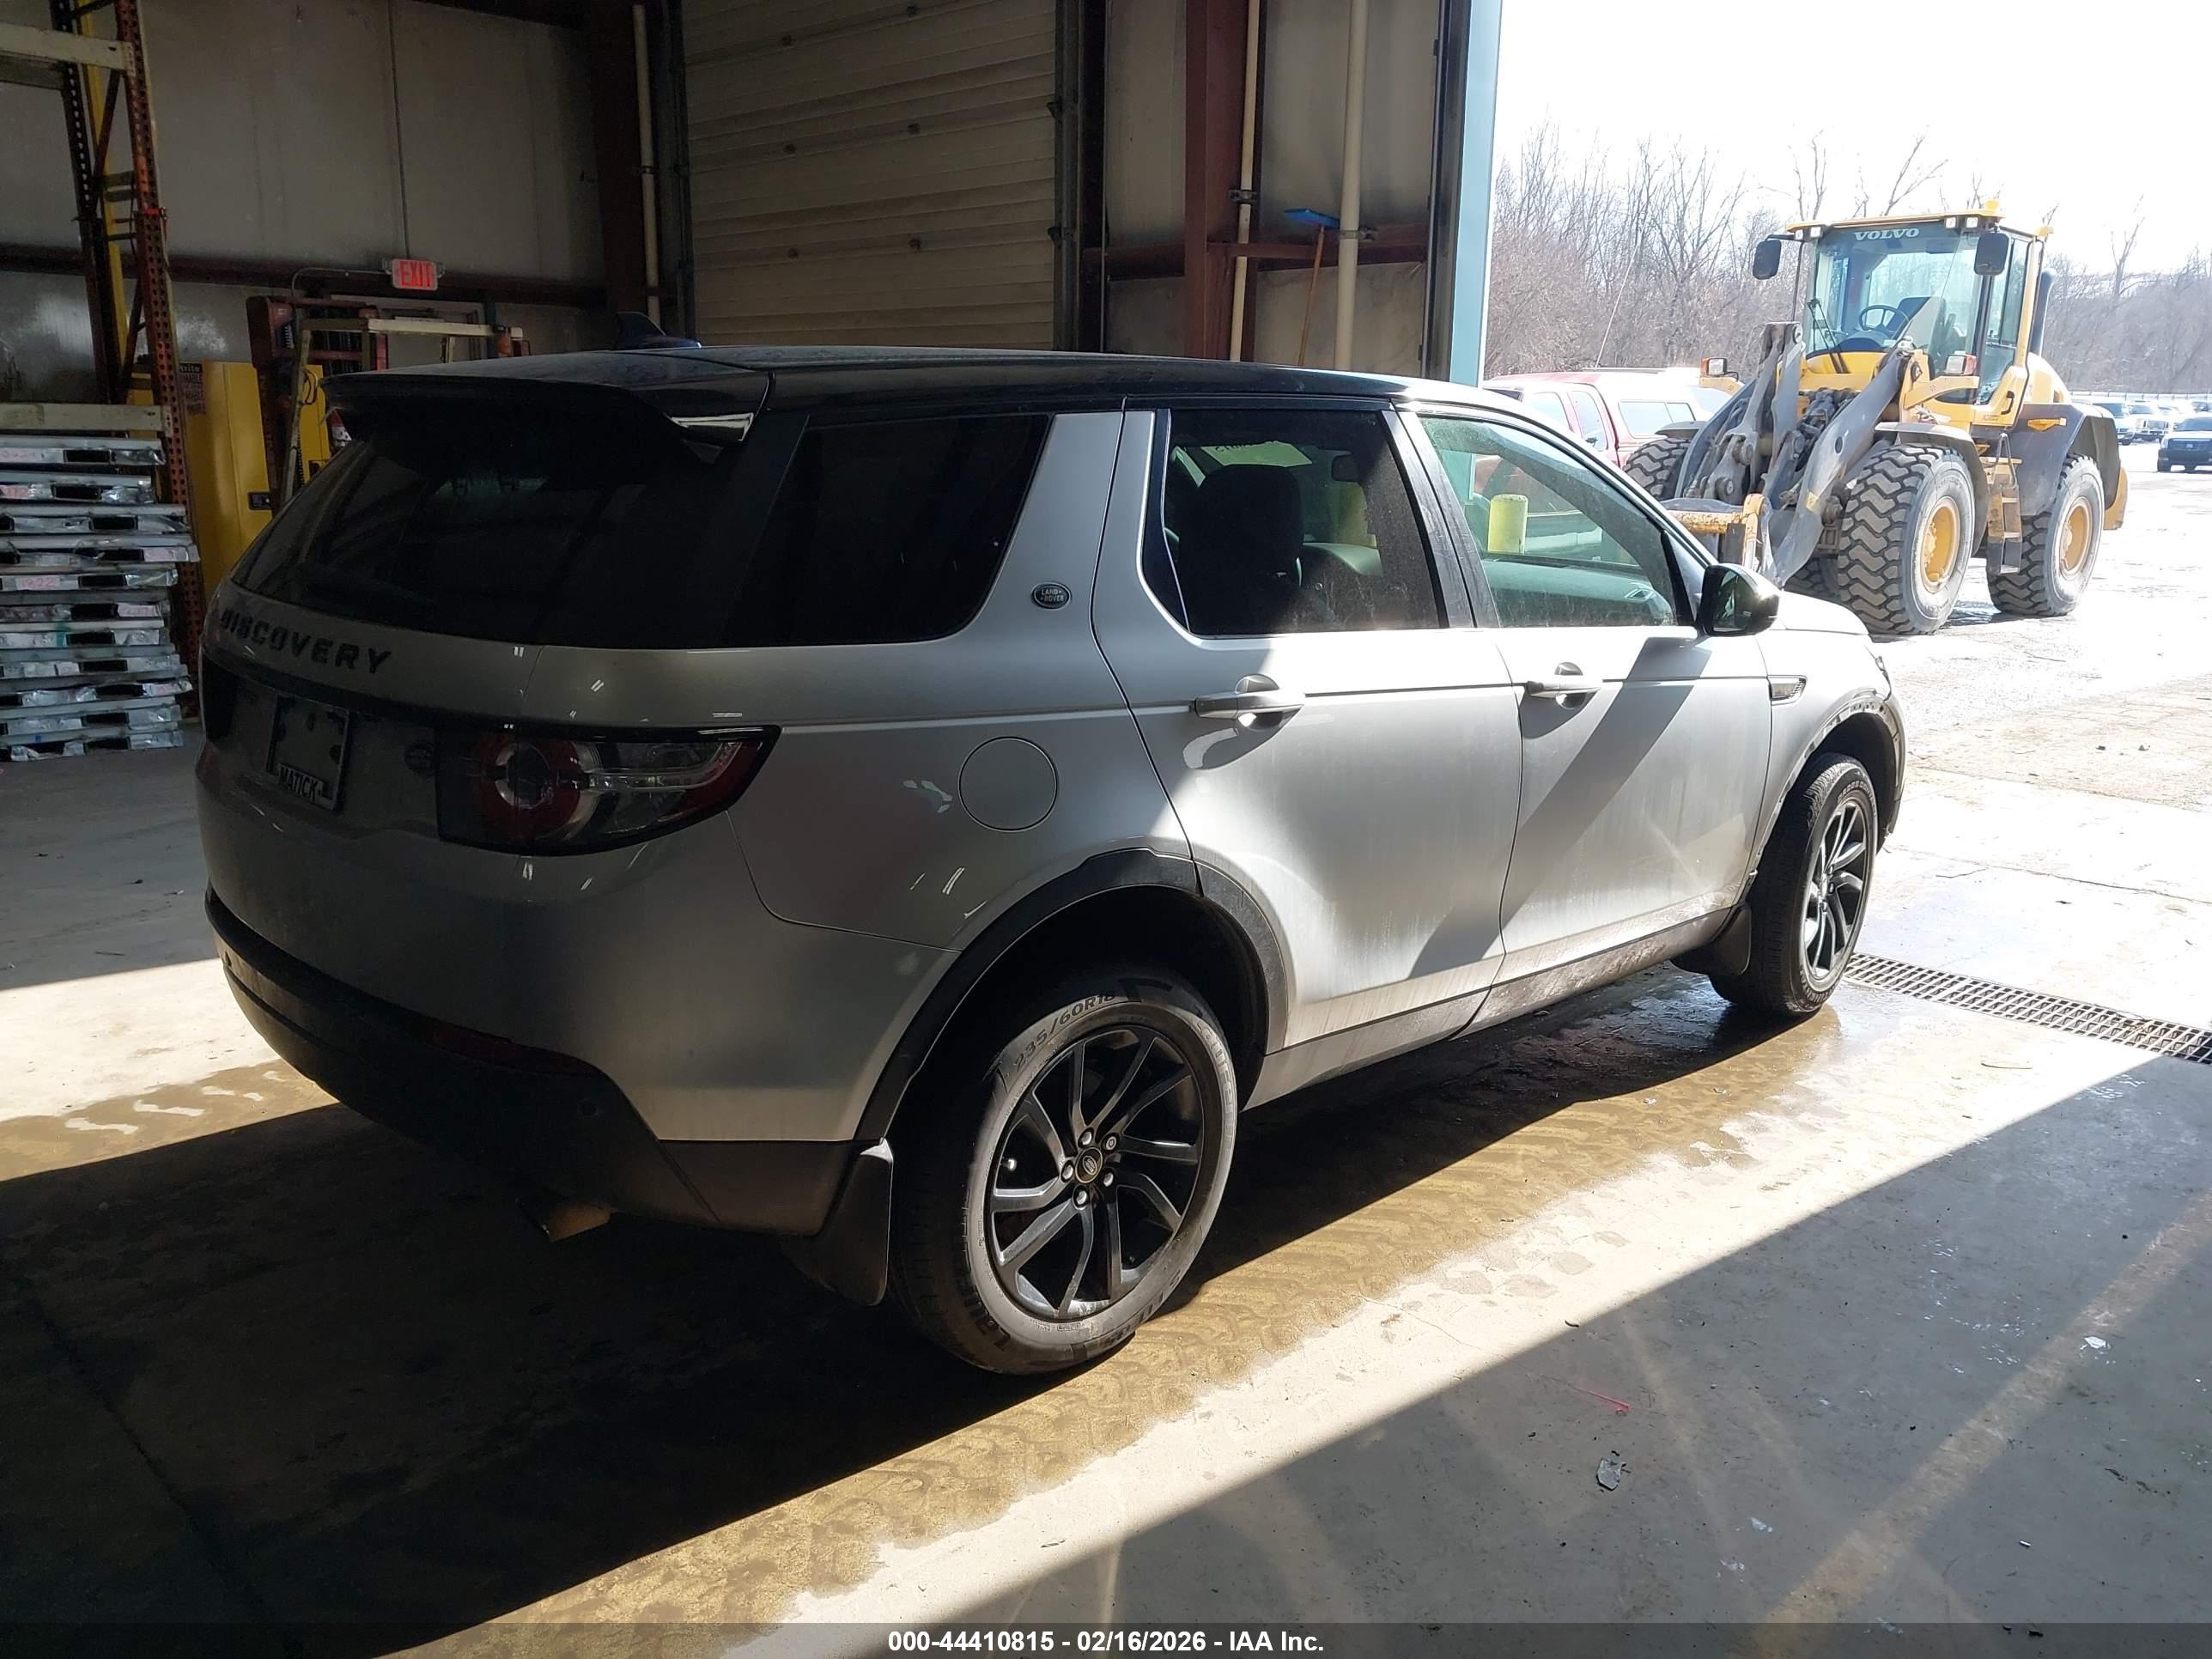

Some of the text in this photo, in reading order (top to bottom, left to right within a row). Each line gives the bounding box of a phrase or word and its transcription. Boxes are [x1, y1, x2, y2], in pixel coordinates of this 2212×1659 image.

[1853, 228, 1919, 240] VOLVO
[399, 260, 432, 288] EXIT
[220, 608, 392, 674] DISCOVERY
